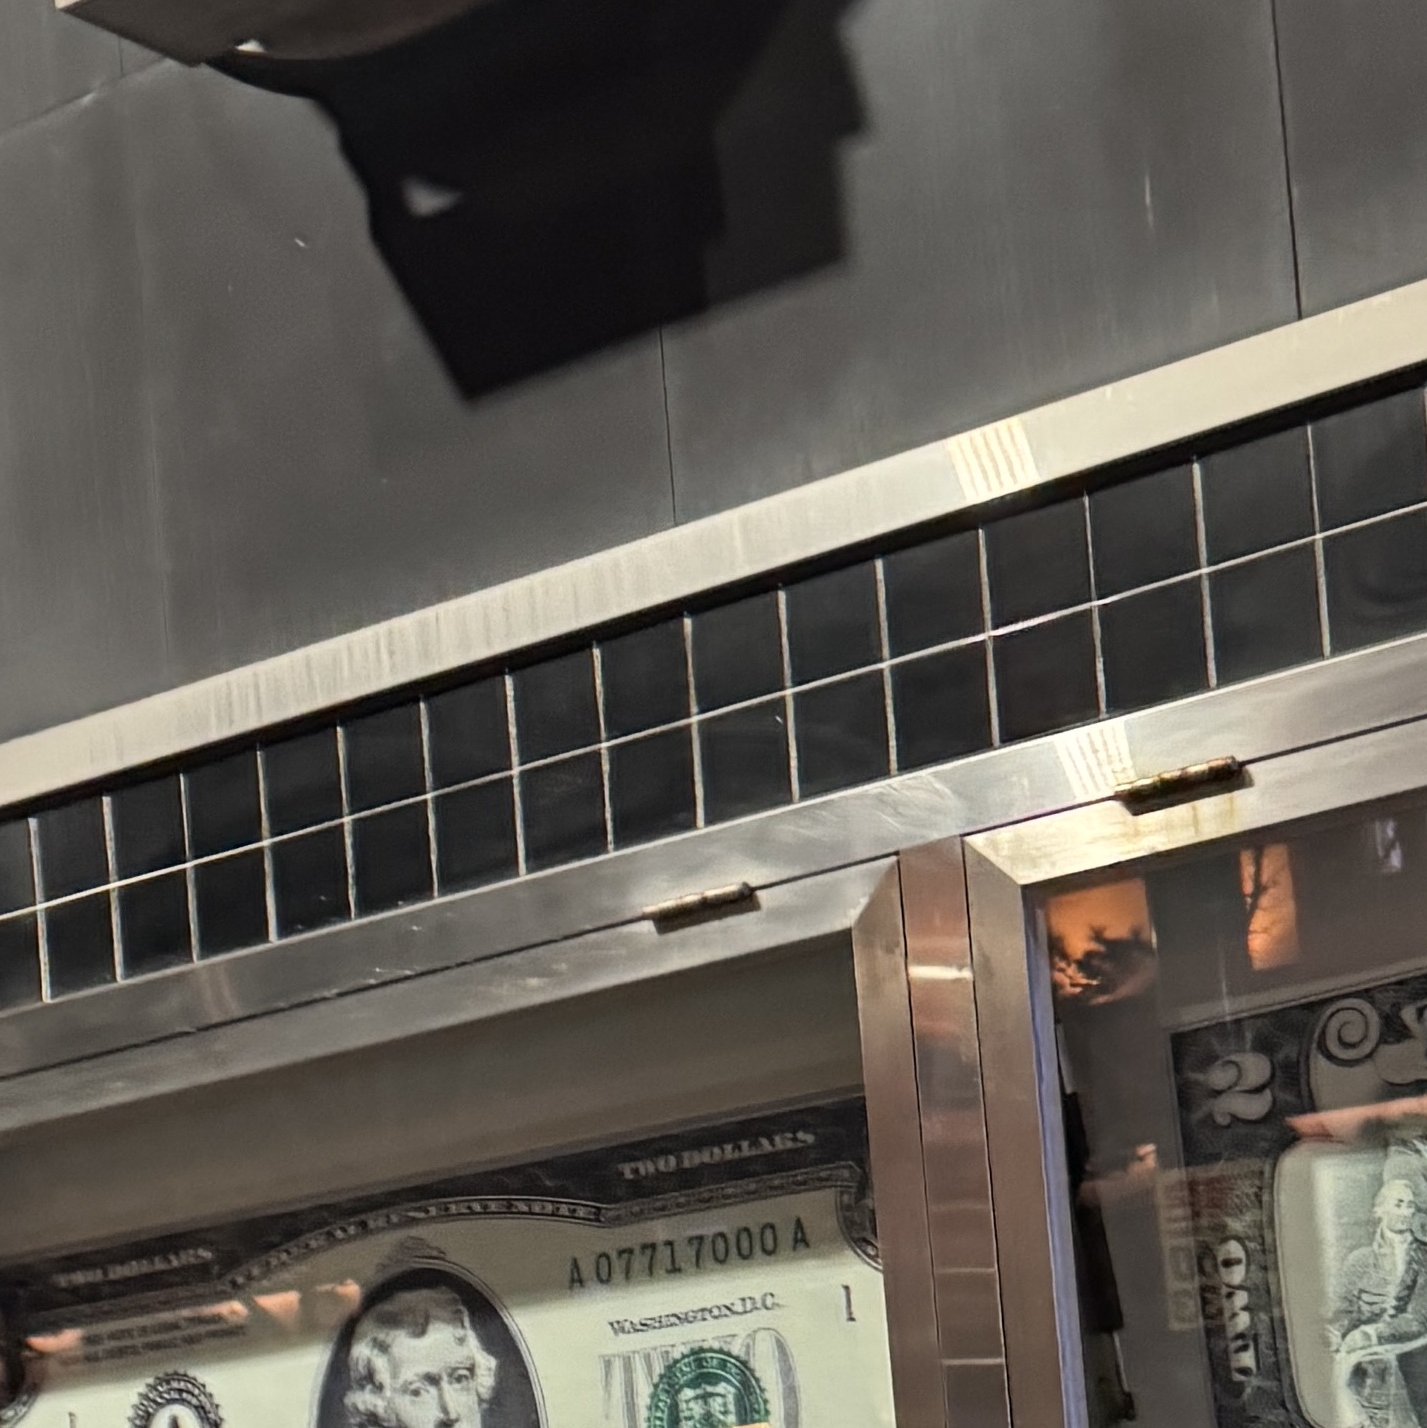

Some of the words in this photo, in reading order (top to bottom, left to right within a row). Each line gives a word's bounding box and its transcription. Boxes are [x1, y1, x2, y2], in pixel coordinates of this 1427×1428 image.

[1209, 1050, 1274, 1127] 2
[617, 1154, 678, 1181] TWO
[680, 1129, 818, 1170] DOLLARS
